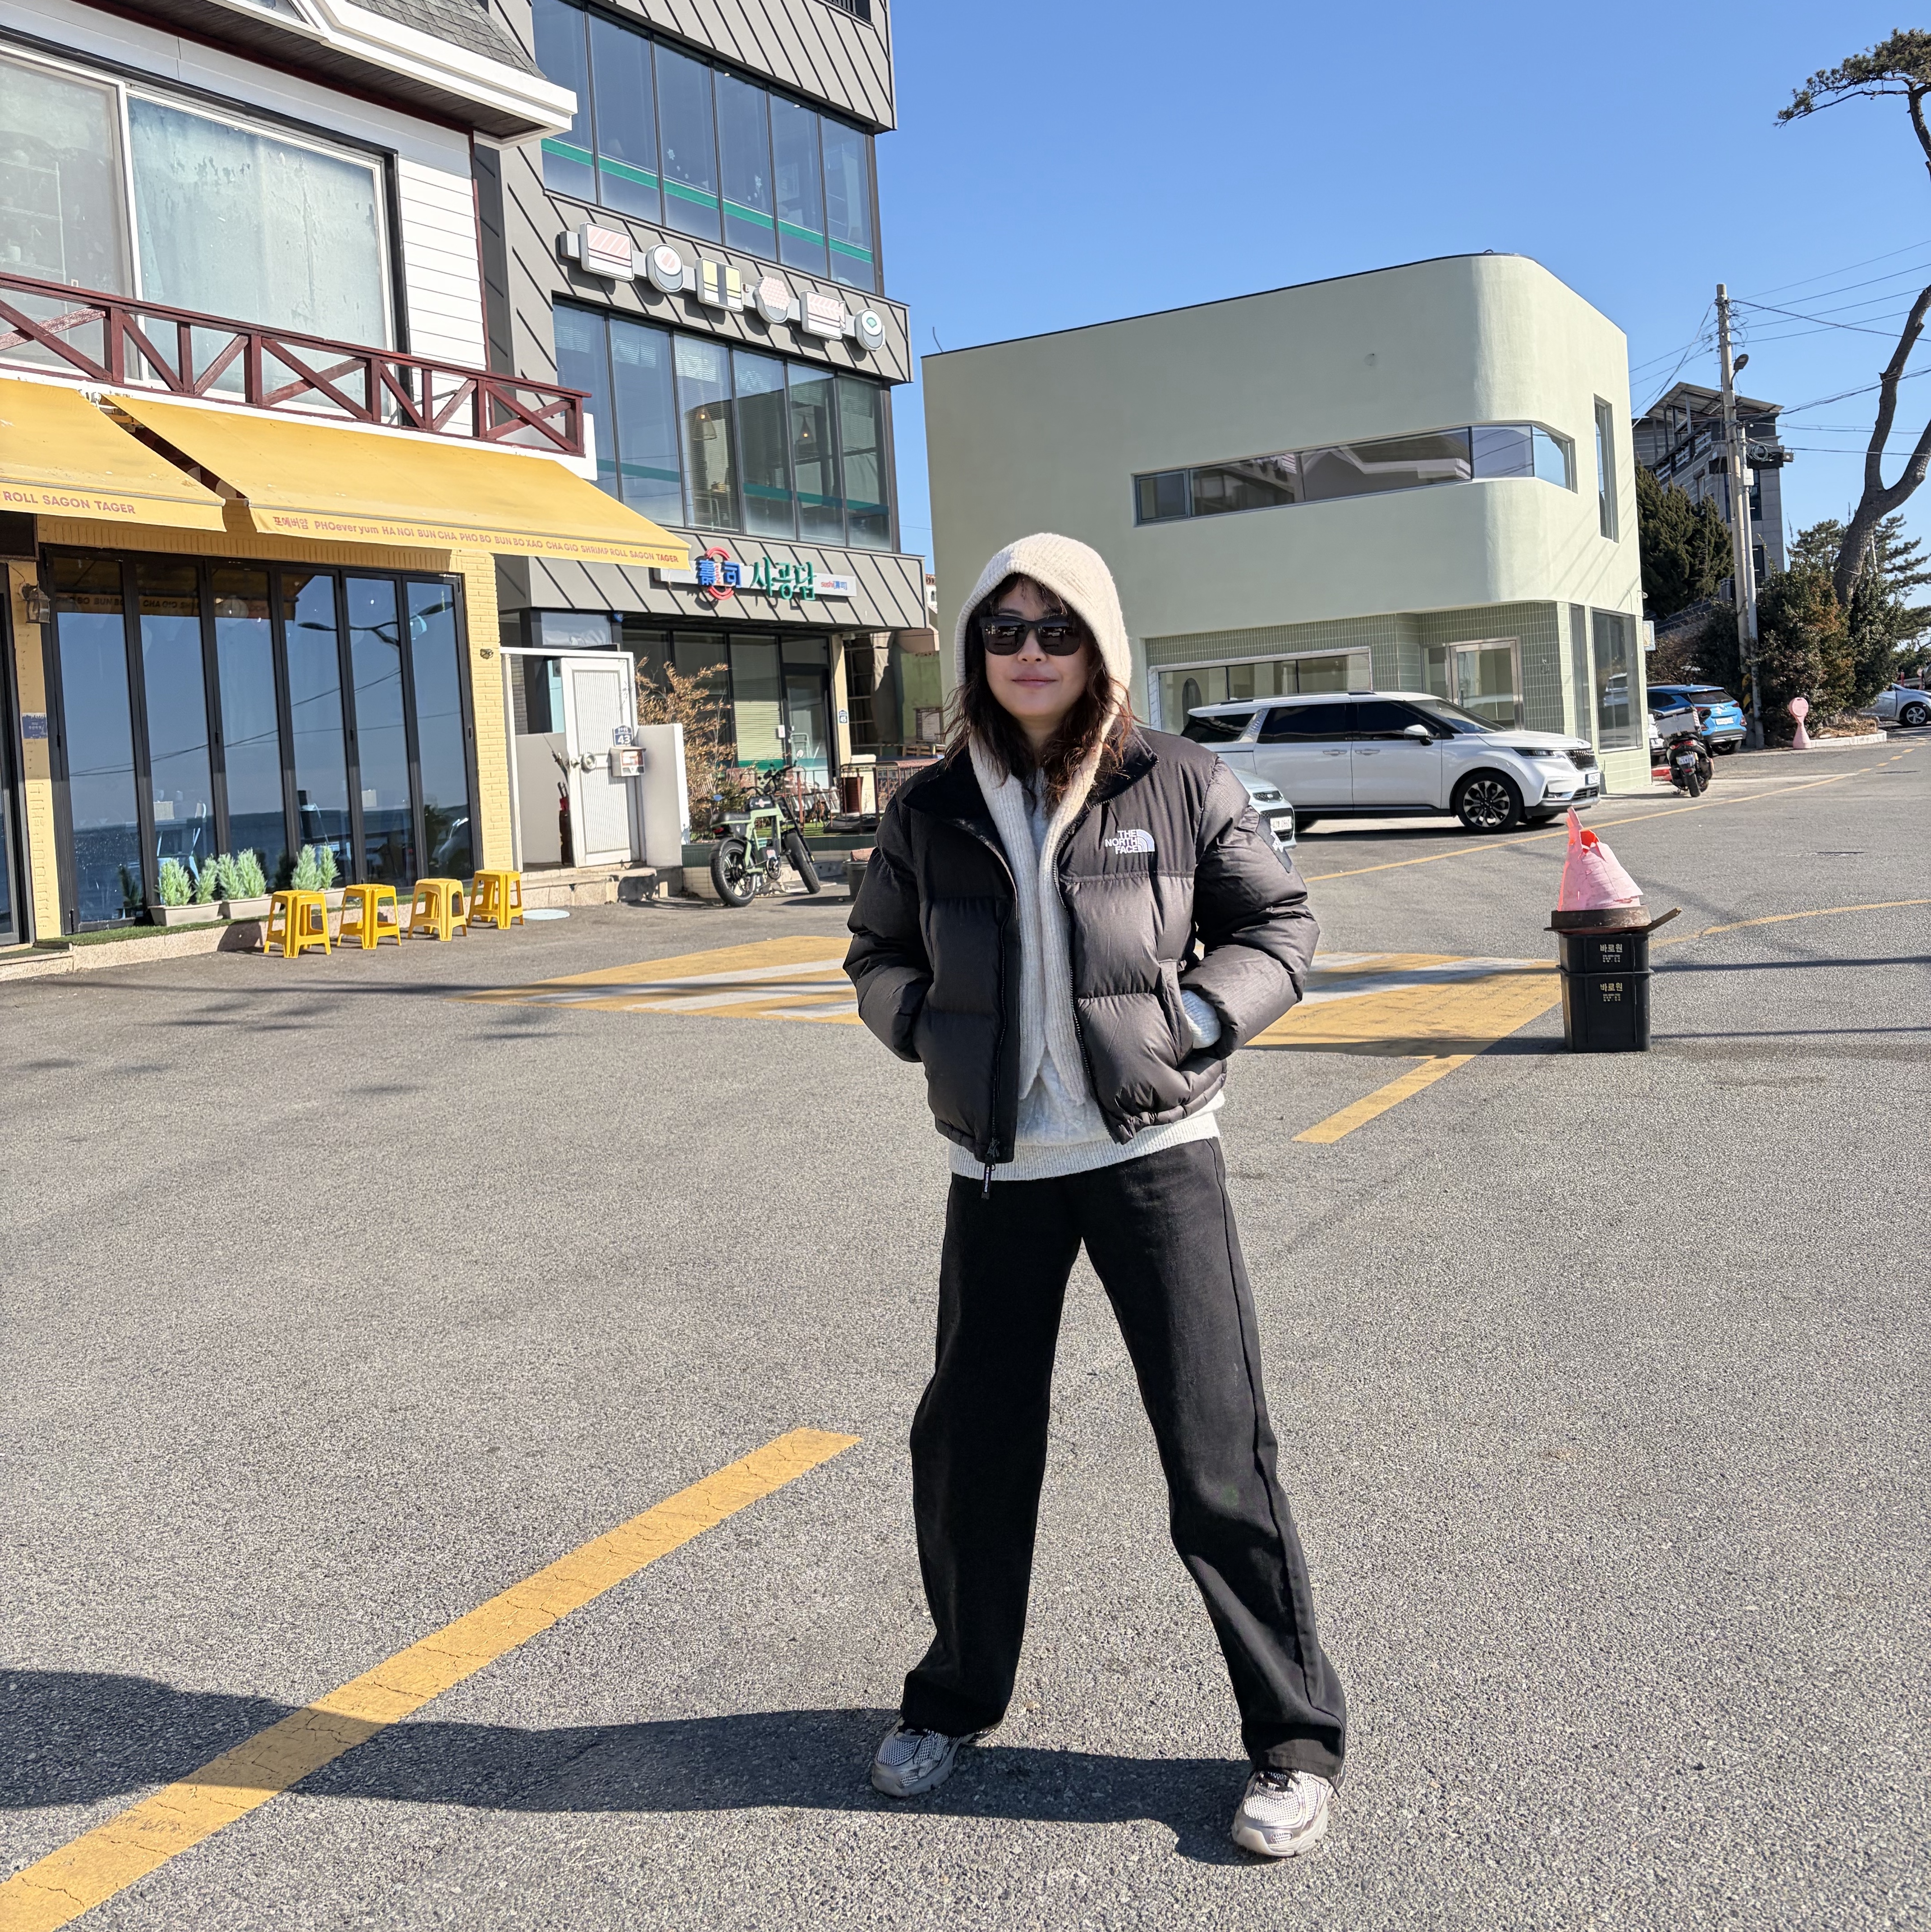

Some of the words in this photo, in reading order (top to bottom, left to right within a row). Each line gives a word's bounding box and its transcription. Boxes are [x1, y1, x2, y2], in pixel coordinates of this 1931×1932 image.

[3, 491, 38, 504] ROLL
[42, 495, 90, 509] SAGON
[94, 500, 136, 514] TAGER
[273, 517, 308, 529] 포에버얌
[417, 529, 436, 538] BUN
[438, 531, 457, 540] CHA
[459, 533, 478, 542] PHO
[479, 535, 491, 543] BO
[495, 536, 512, 545] BUN
[526, 540, 543, 548] XAO
[546, 542, 563, 550] CHA
[564, 543, 578, 551] GIO
[581, 546, 608, 554] SHRIMP
[610, 548, 628, 557] ROLL
[629, 551, 654, 560] SAGON
[656, 554, 679, 562] TAGER
[618, 735, 631, 744] 43
[1117, 829, 1137, 838] THE
[1105, 837, 1138, 847] NORTH
[1115, 845, 1138, 854] FACE
[1600, 943, 1623, 953] 바로원
[1600, 982, 1623, 992] 바로원
